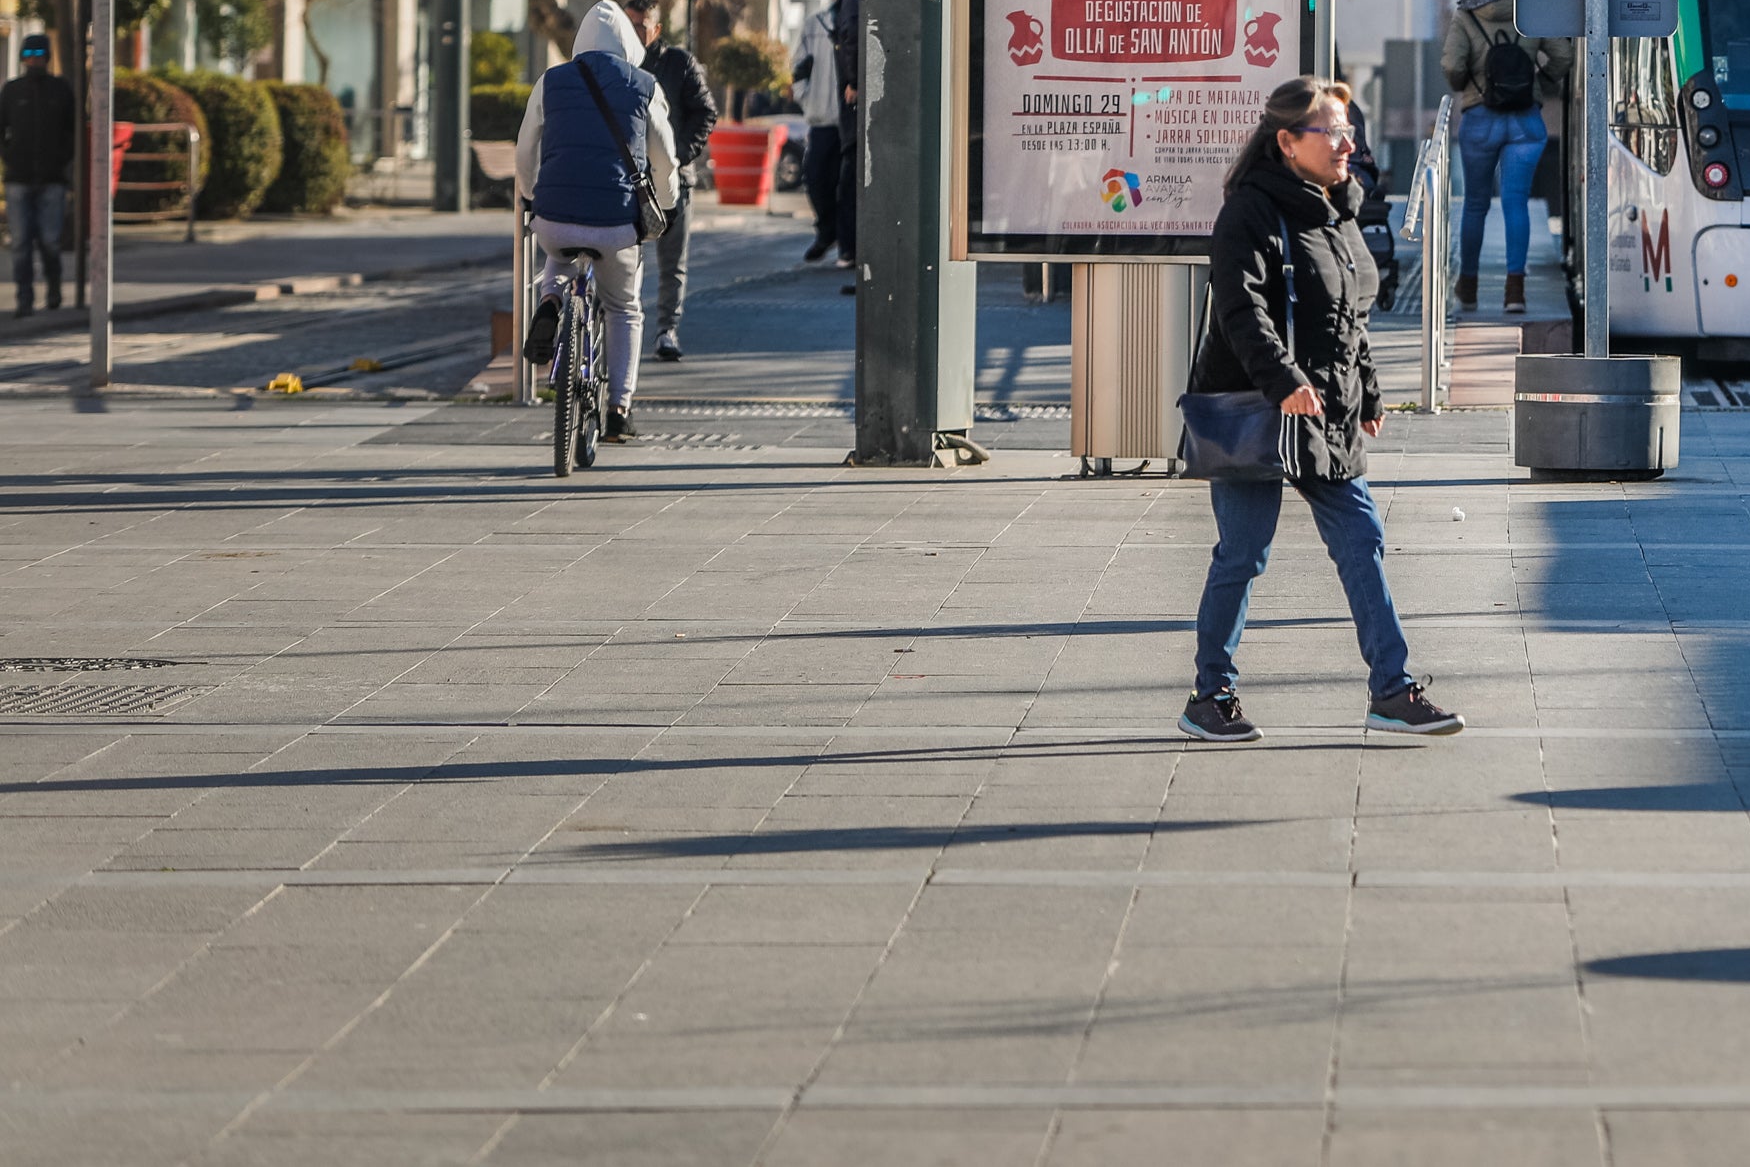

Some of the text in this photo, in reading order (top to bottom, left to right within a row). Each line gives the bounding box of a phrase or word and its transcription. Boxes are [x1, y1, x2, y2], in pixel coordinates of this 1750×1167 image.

[1186, 3, 1202, 23] DE
[1065, 22, 1222, 55] OLLA DE SAN ANTÓN
[1022, 94, 1121, 114] DOMINGO 29
[1188, 90, 1202, 105] DE
[1207, 90, 1260, 105] MATANZA
[1155, 107, 1264, 124] MÚSICA EN DIRECT
[1021, 118, 1121, 134] EN LA PLAZA ESPAÑA
[1021, 140, 1046, 151] DESDE
[1050, 140, 1063, 151] LAS
[1067, 138, 1097, 151] 13:00
[1155, 129, 1250, 145] JARRA SOLIDARI
[1145, 175, 1192, 184] ARMILLA
[1145, 184, 1192, 194] AVANZA
[1145, 191, 1193, 210] contigo
[1151, 220, 1179, 230] VECINOS
[1182, 220, 1202, 230] SANTA
[1640, 208, 1673, 292] M
